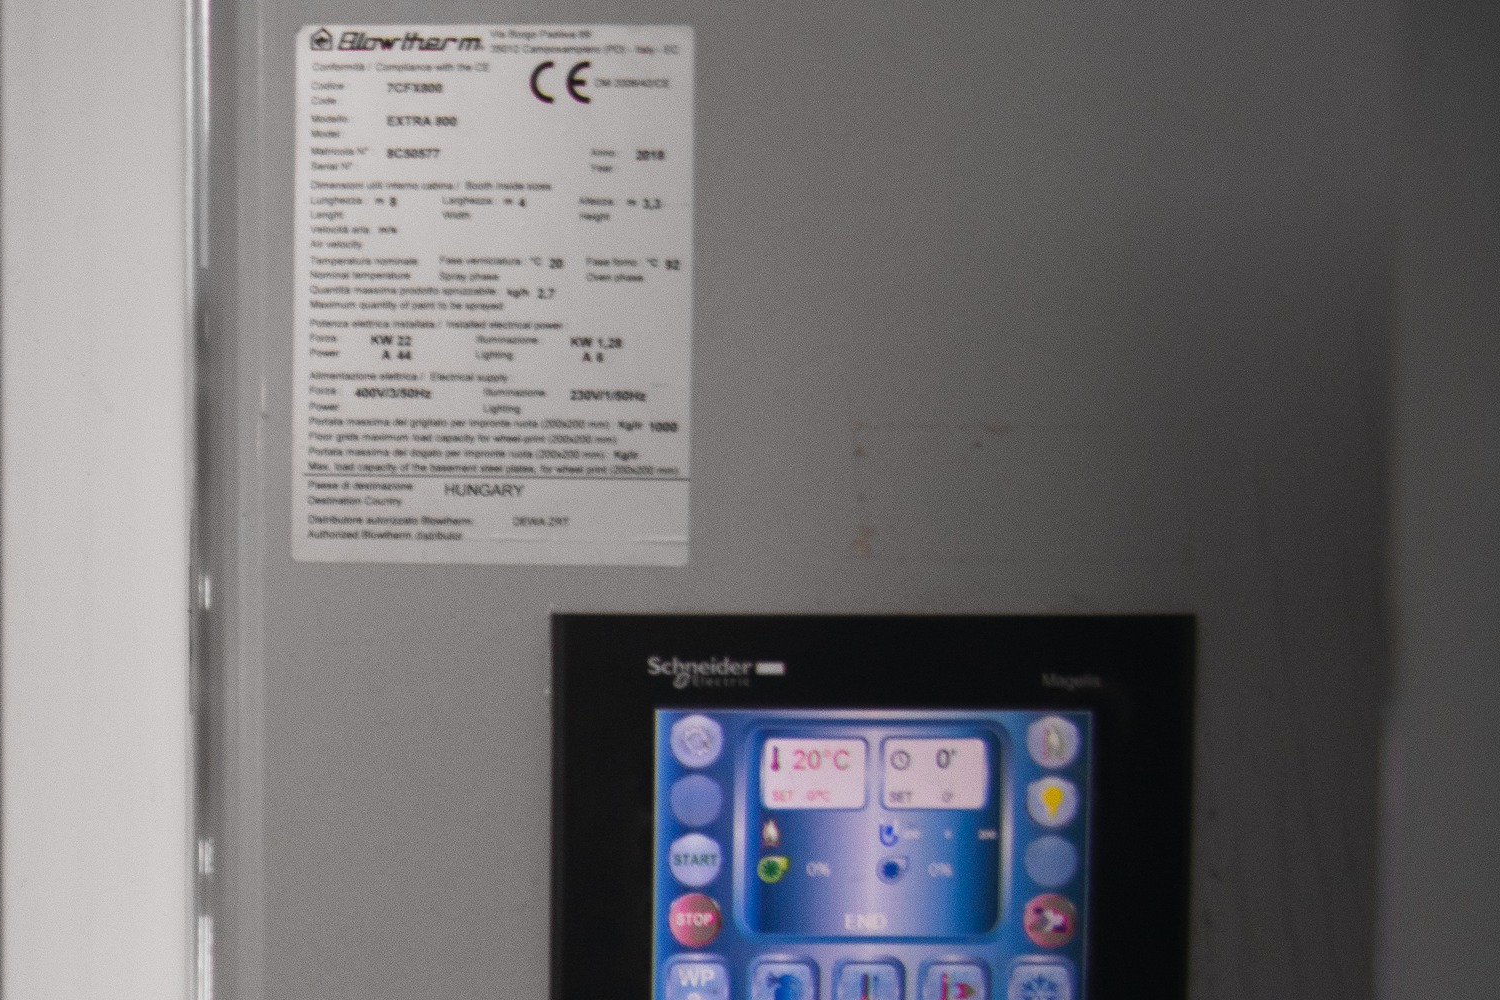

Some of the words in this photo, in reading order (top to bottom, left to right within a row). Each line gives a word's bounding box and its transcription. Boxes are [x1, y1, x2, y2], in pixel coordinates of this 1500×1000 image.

[387, 116, 431, 126] EXTRA
[444, 483, 524, 497] HUNGARY
[647, 656, 752, 676] Schneider
[673, 853, 718, 867] START
[675, 911, 715, 927] STOP
